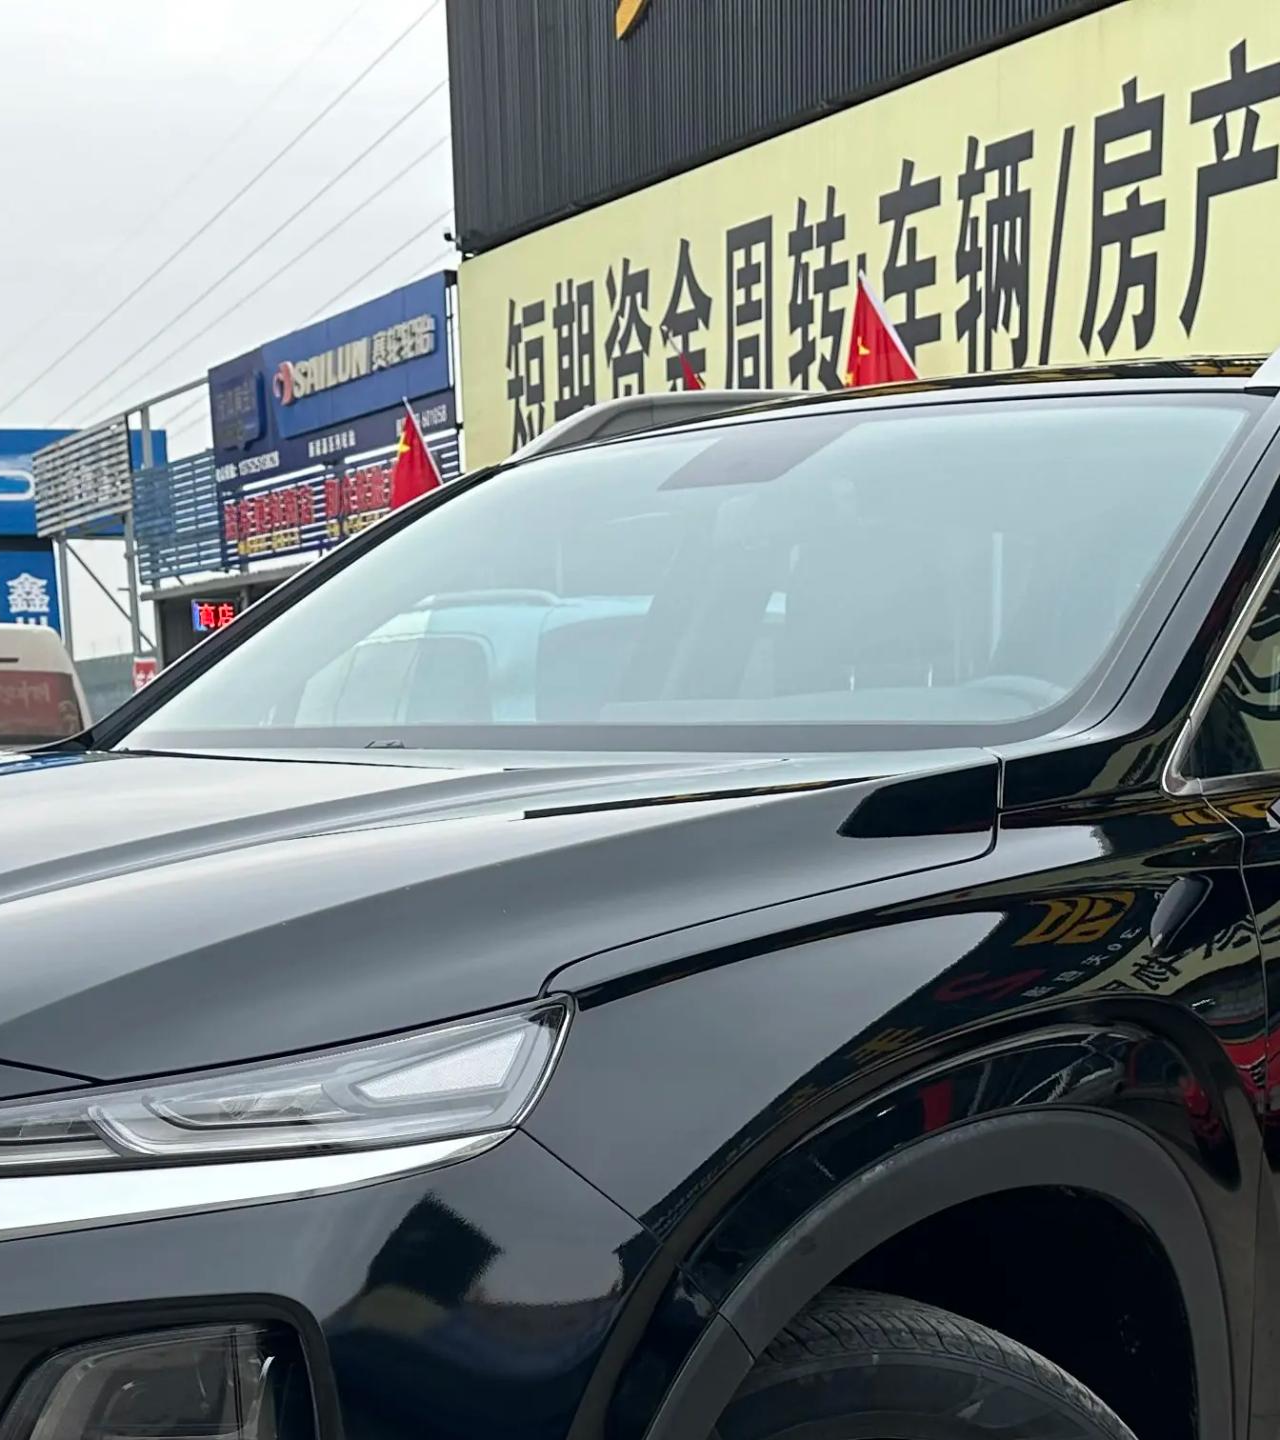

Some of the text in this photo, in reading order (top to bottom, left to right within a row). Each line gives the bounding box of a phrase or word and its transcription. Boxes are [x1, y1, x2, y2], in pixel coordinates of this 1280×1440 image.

[293, 337, 371, 398] SAILUN
[6, 573, 50, 627] 鑫
[198, 603, 235, 628] 商店
